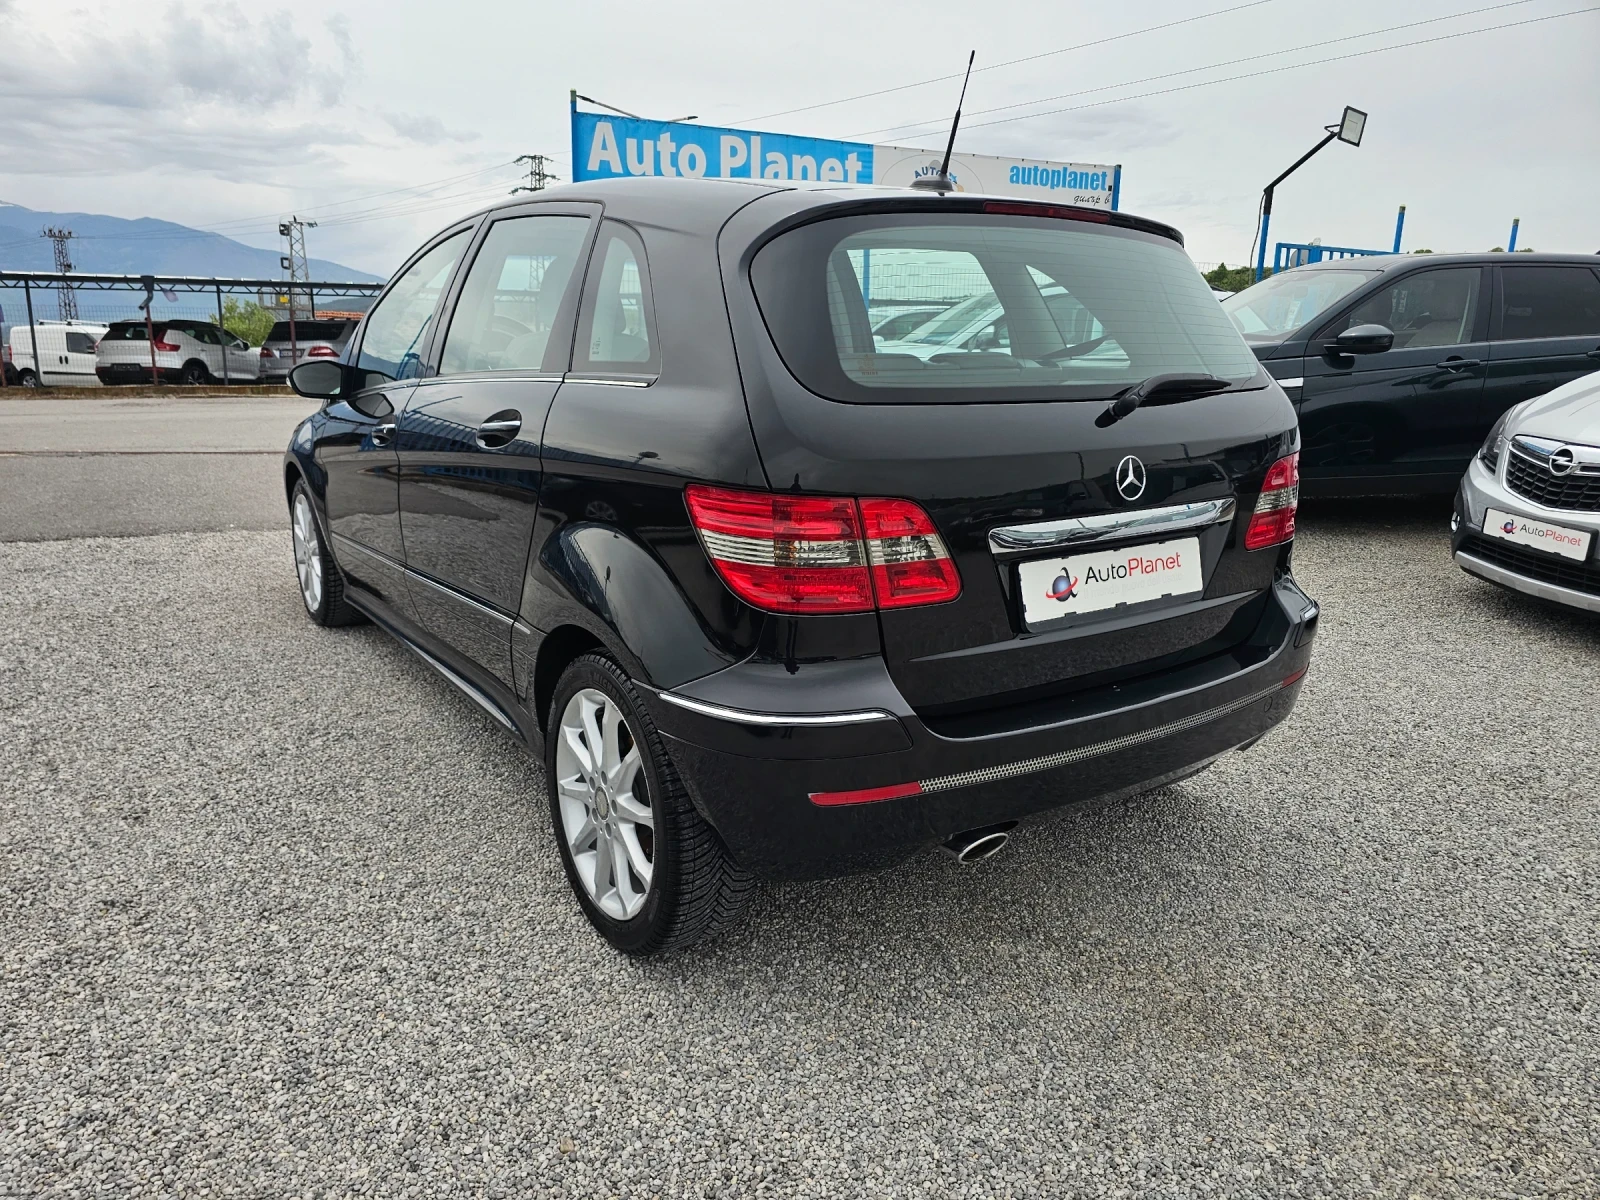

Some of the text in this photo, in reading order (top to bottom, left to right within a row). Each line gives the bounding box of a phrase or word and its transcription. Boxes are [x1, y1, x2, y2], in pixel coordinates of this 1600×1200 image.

[587, 121, 863, 184] Auto Planet
[1520, 523, 1582, 547] AutoPlanet
[1085, 552, 1182, 585] AutoPlanet
